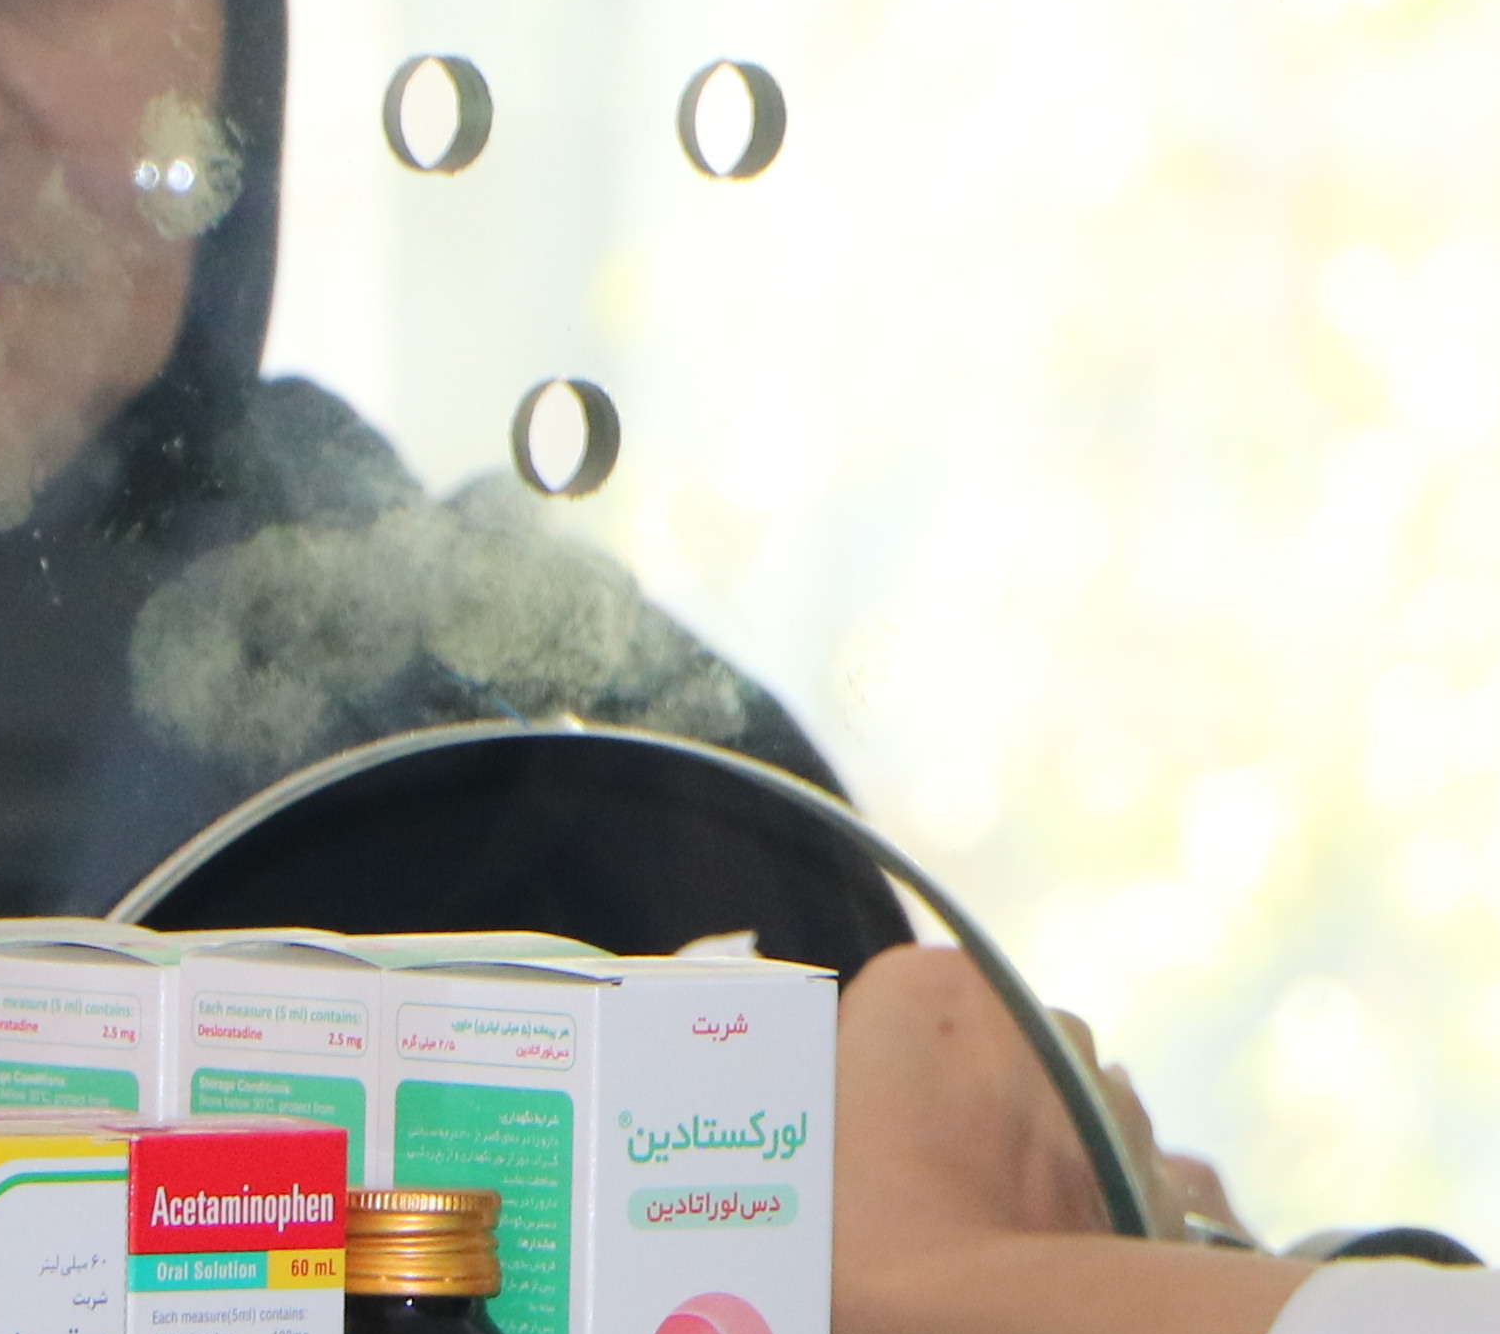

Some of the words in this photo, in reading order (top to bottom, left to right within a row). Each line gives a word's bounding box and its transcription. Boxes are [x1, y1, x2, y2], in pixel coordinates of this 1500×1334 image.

[199, 1000, 223, 1016] Each
[226, 1005, 272, 1020] measure
[120, 1028, 137, 1043] mg
[198, 1023, 263, 1041] Desloratadine
[328, 1032, 344, 1046] 2.5
[346, 1035, 363, 1050] mg
[691, 1011, 749, 1041] شربت
[626, 1111, 807, 1164] لورکستادین
[151, 1183, 334, 1233] Acetaminophen
[157, 1261, 189, 1281] Oral
[194, 1260, 257, 1280] Solution
[291, 1259, 309, 1277] 60
[315, 1258, 337, 1276] mL
[72, 1291, 108, 1311] شربت
[152, 1310, 178, 1325] Each
